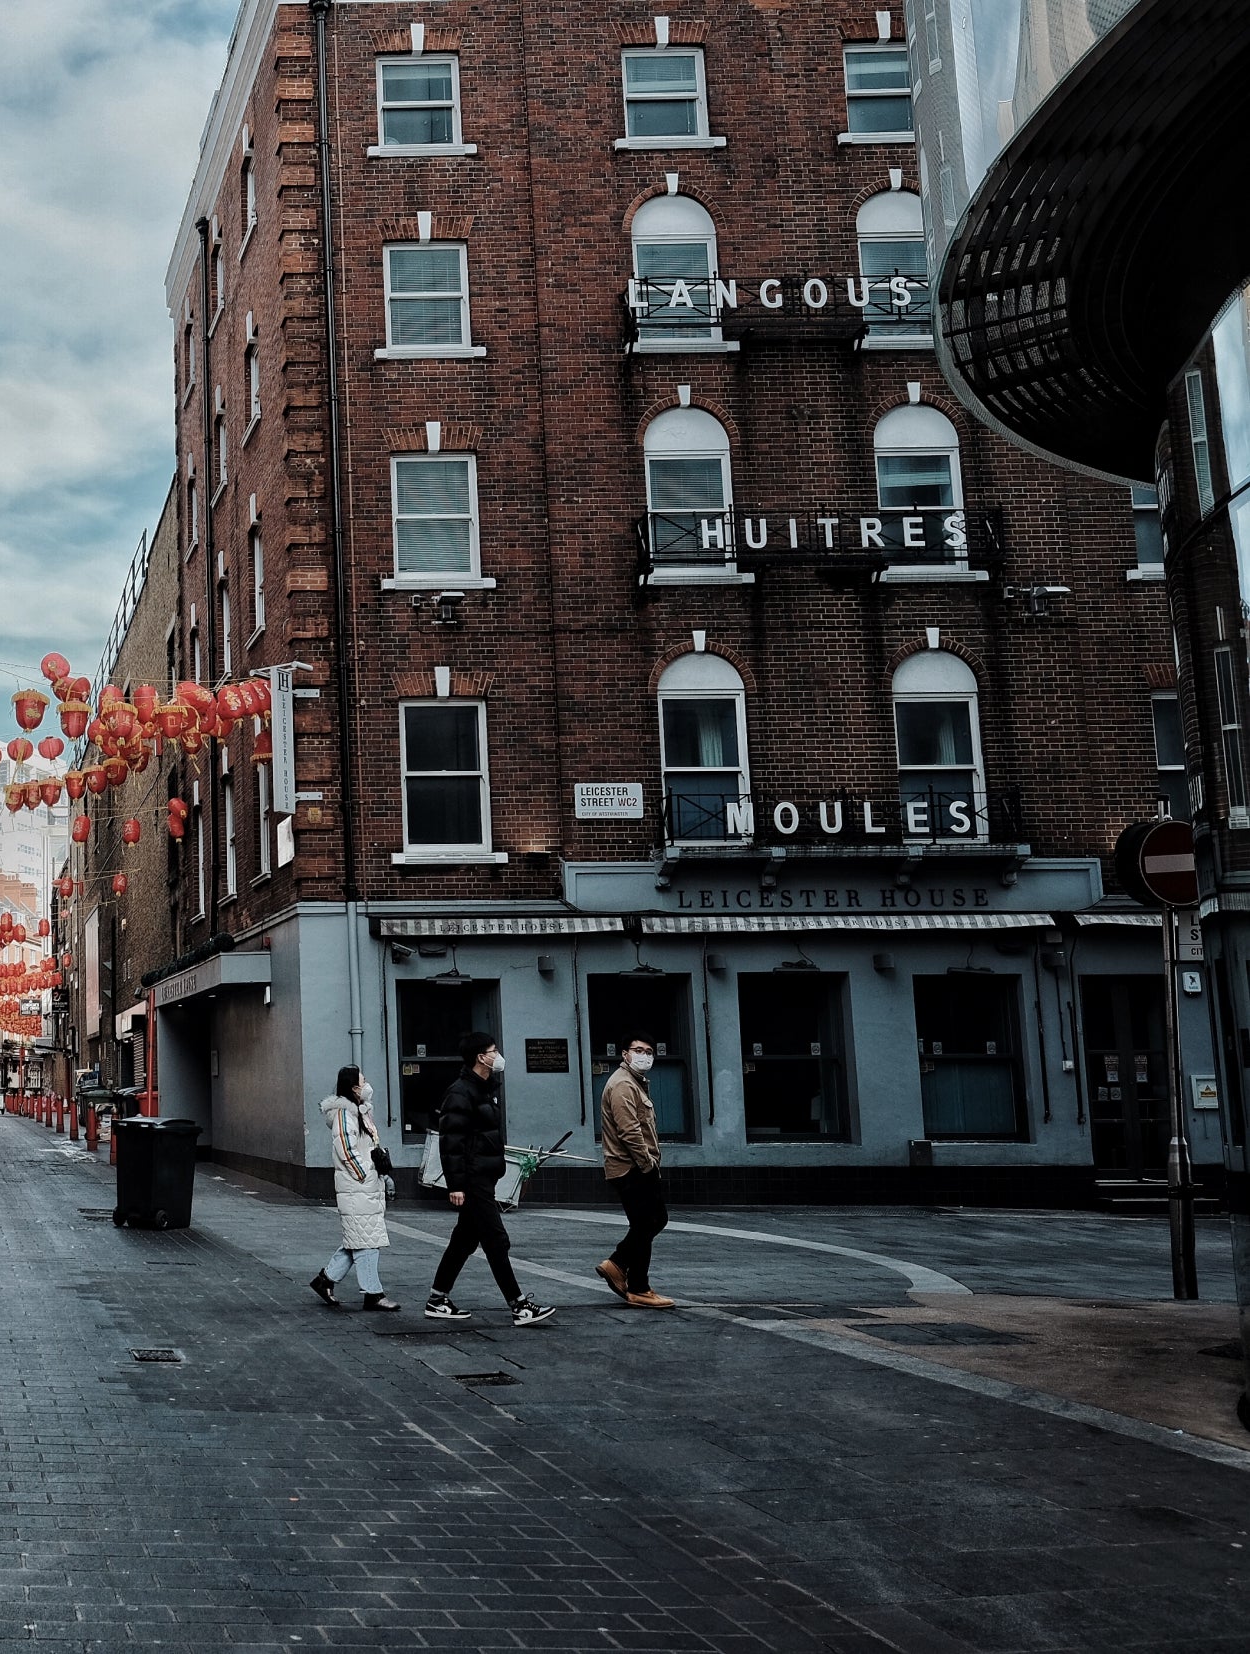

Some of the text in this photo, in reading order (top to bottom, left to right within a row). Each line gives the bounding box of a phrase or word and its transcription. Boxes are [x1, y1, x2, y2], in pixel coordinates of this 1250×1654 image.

[628, 277, 912, 308] LANGOUS
[701, 515, 967, 549] HUITRES
[580, 786, 628, 796] LEICESTER
[580, 797, 638, 807] STREET WC2
[726, 800, 971, 834] MOULES
[677, 888, 989, 909] LEICESTER HOUSE
[439, 922, 565, 932] LEICESTER HOUSE
[866, 918, 910, 927] HOUSE
